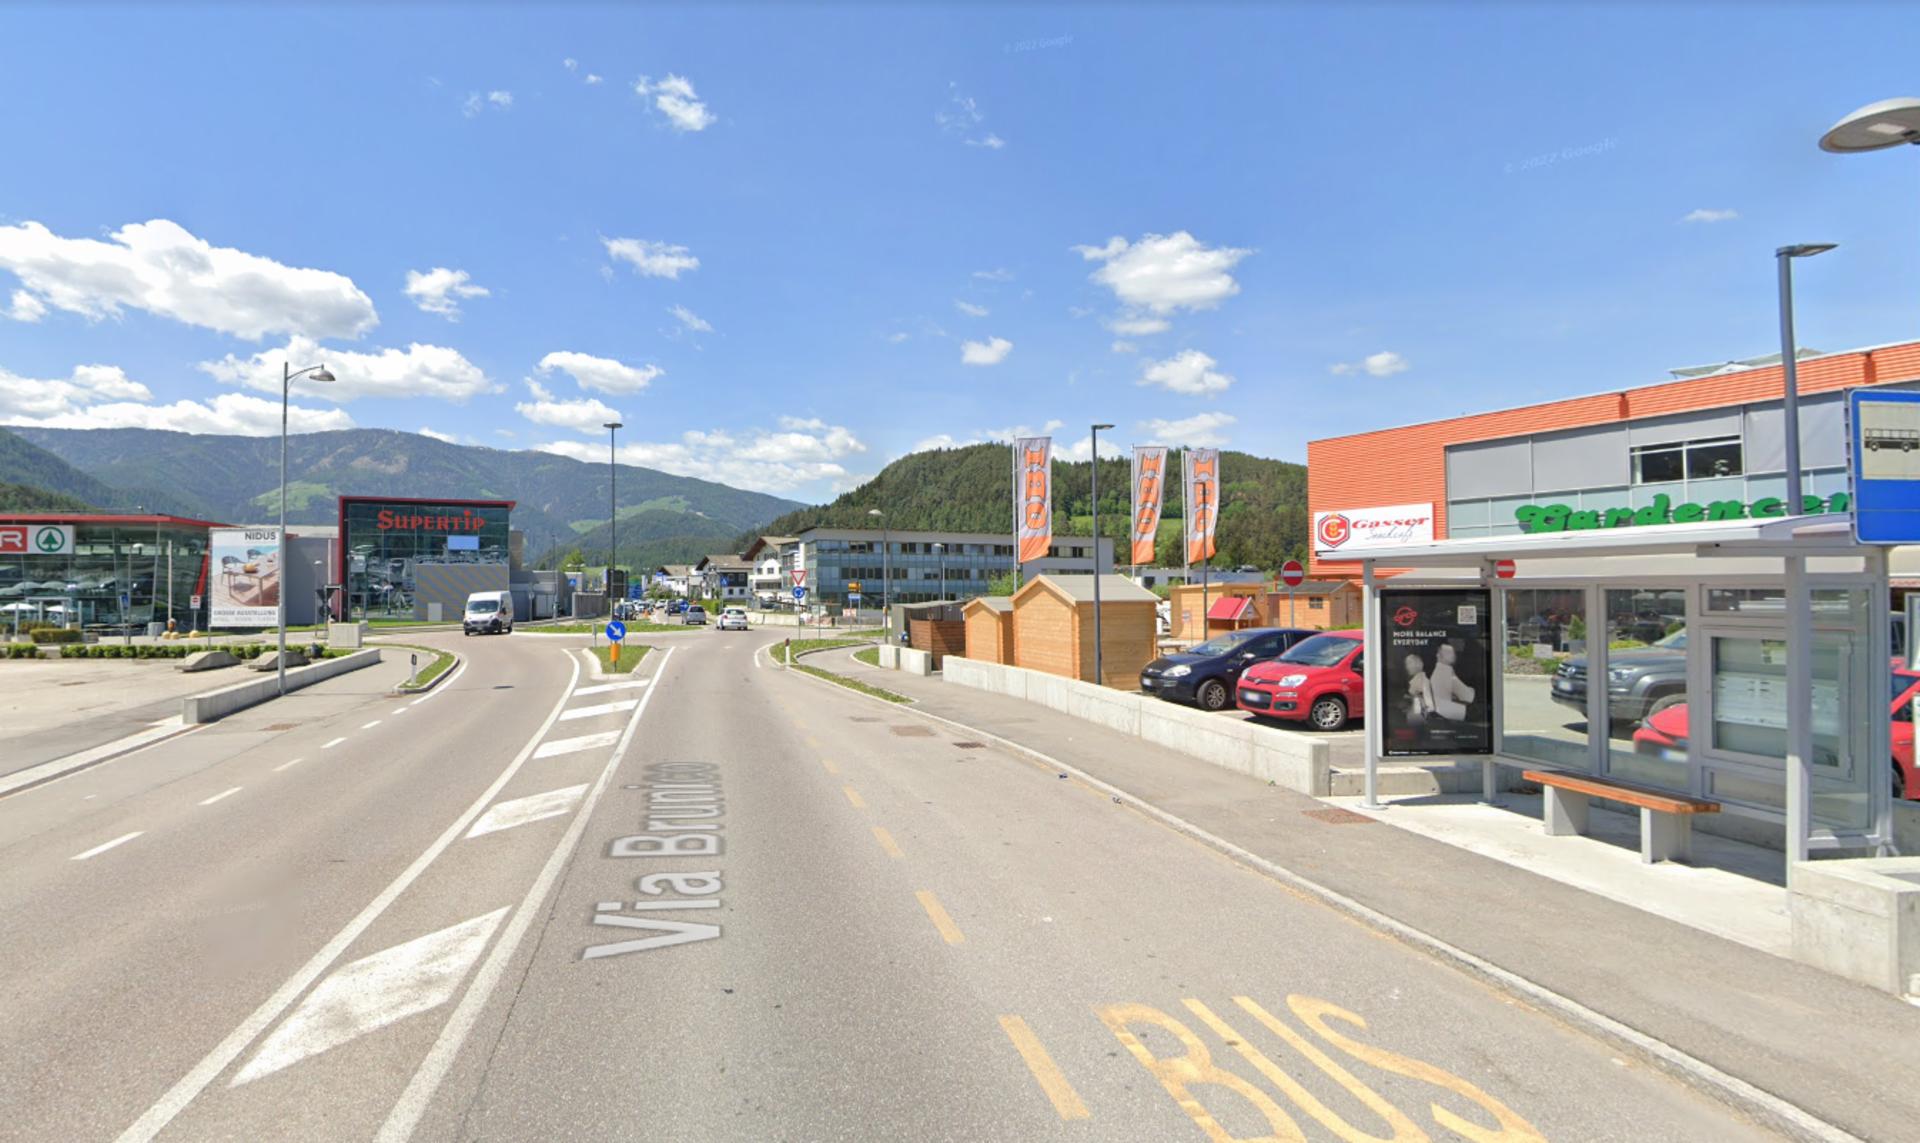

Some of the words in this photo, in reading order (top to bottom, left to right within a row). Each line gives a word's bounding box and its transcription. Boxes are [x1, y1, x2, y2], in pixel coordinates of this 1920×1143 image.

[1351, 517, 1430, 529] Gasser
[244, 531, 276, 540] NIDUS
[1093, 994, 1549, 1143] BUS
